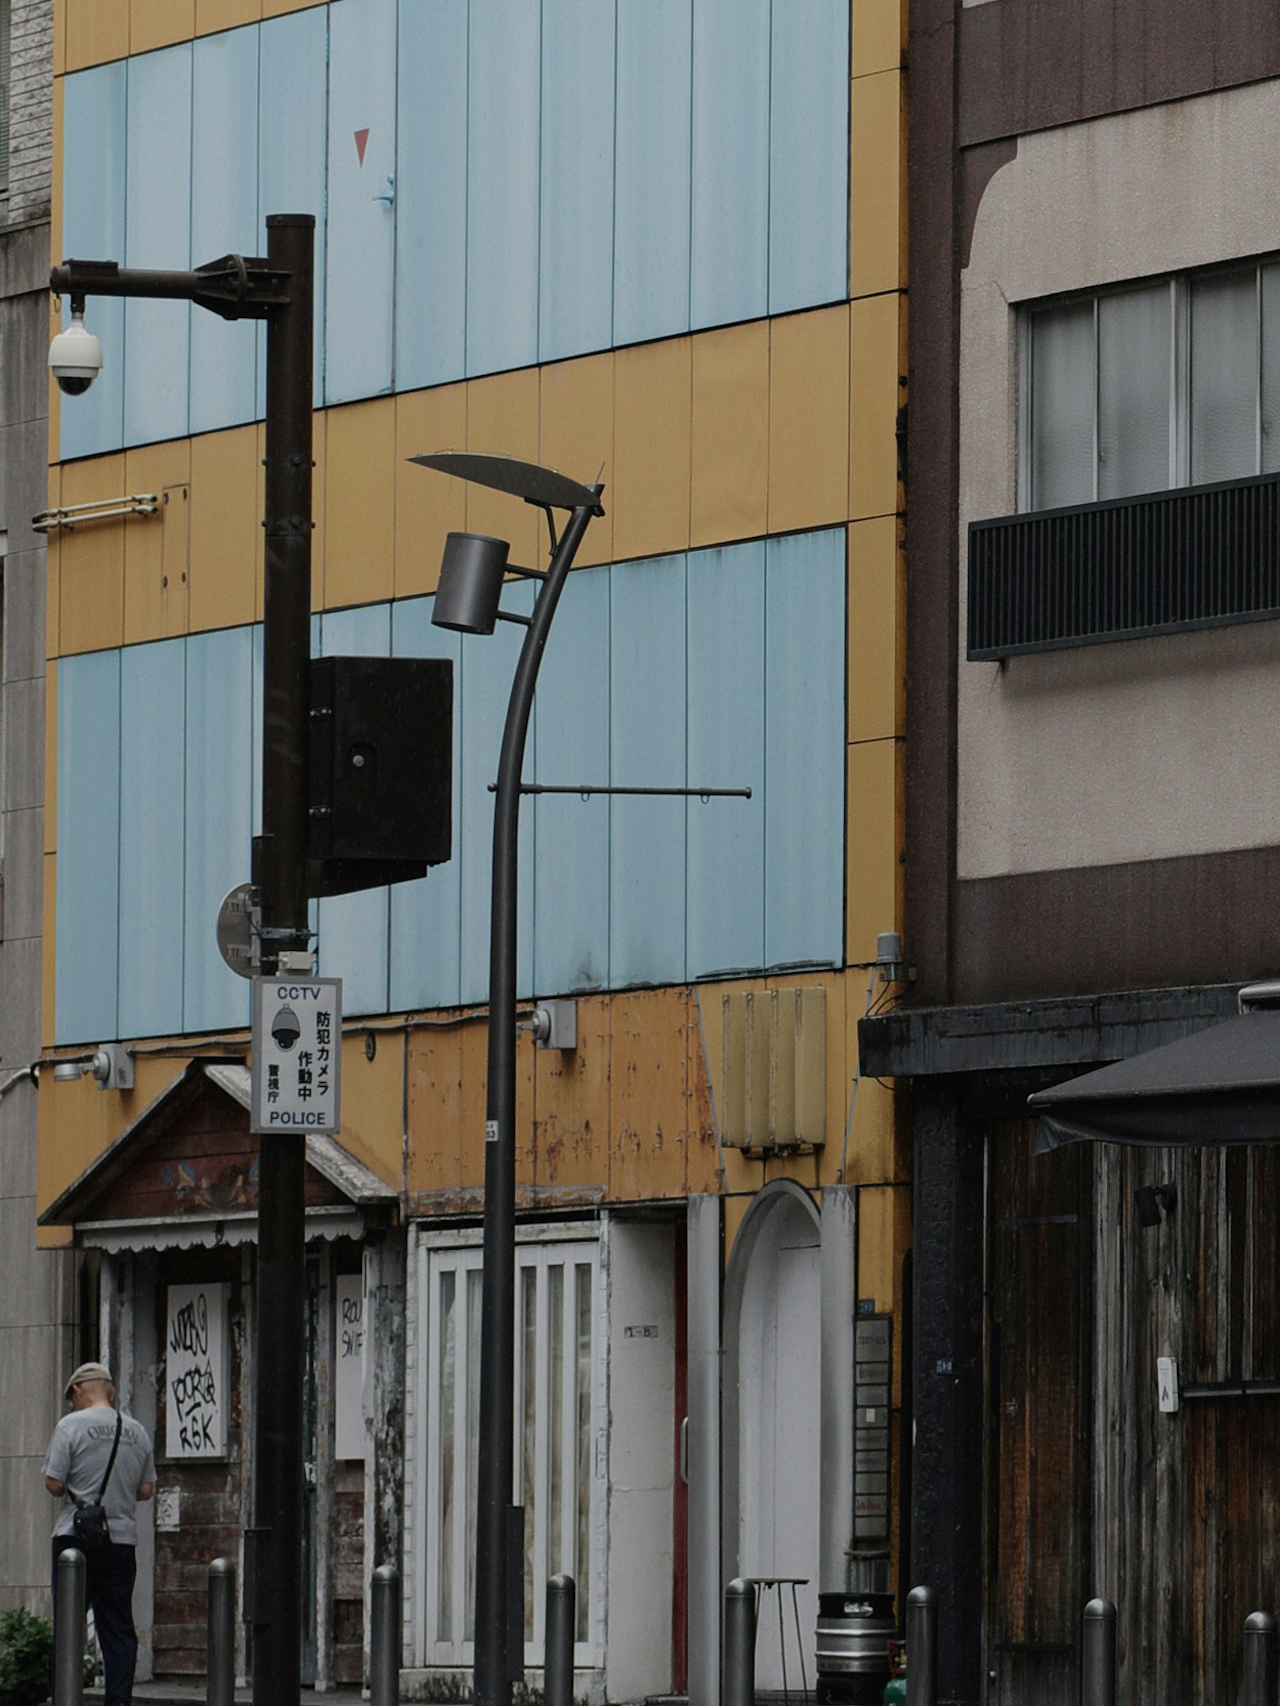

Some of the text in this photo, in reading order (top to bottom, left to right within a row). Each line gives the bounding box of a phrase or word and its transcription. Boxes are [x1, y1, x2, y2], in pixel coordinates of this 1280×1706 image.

[277, 986, 321, 1000] CCTV
[316, 1011, 331, 1096] 防犯カメラ
[267, 1064, 279, 1103] 警視庁
[298, 1051, 313, 1102] 作動中
[269, 1111, 326, 1125] POLICE
